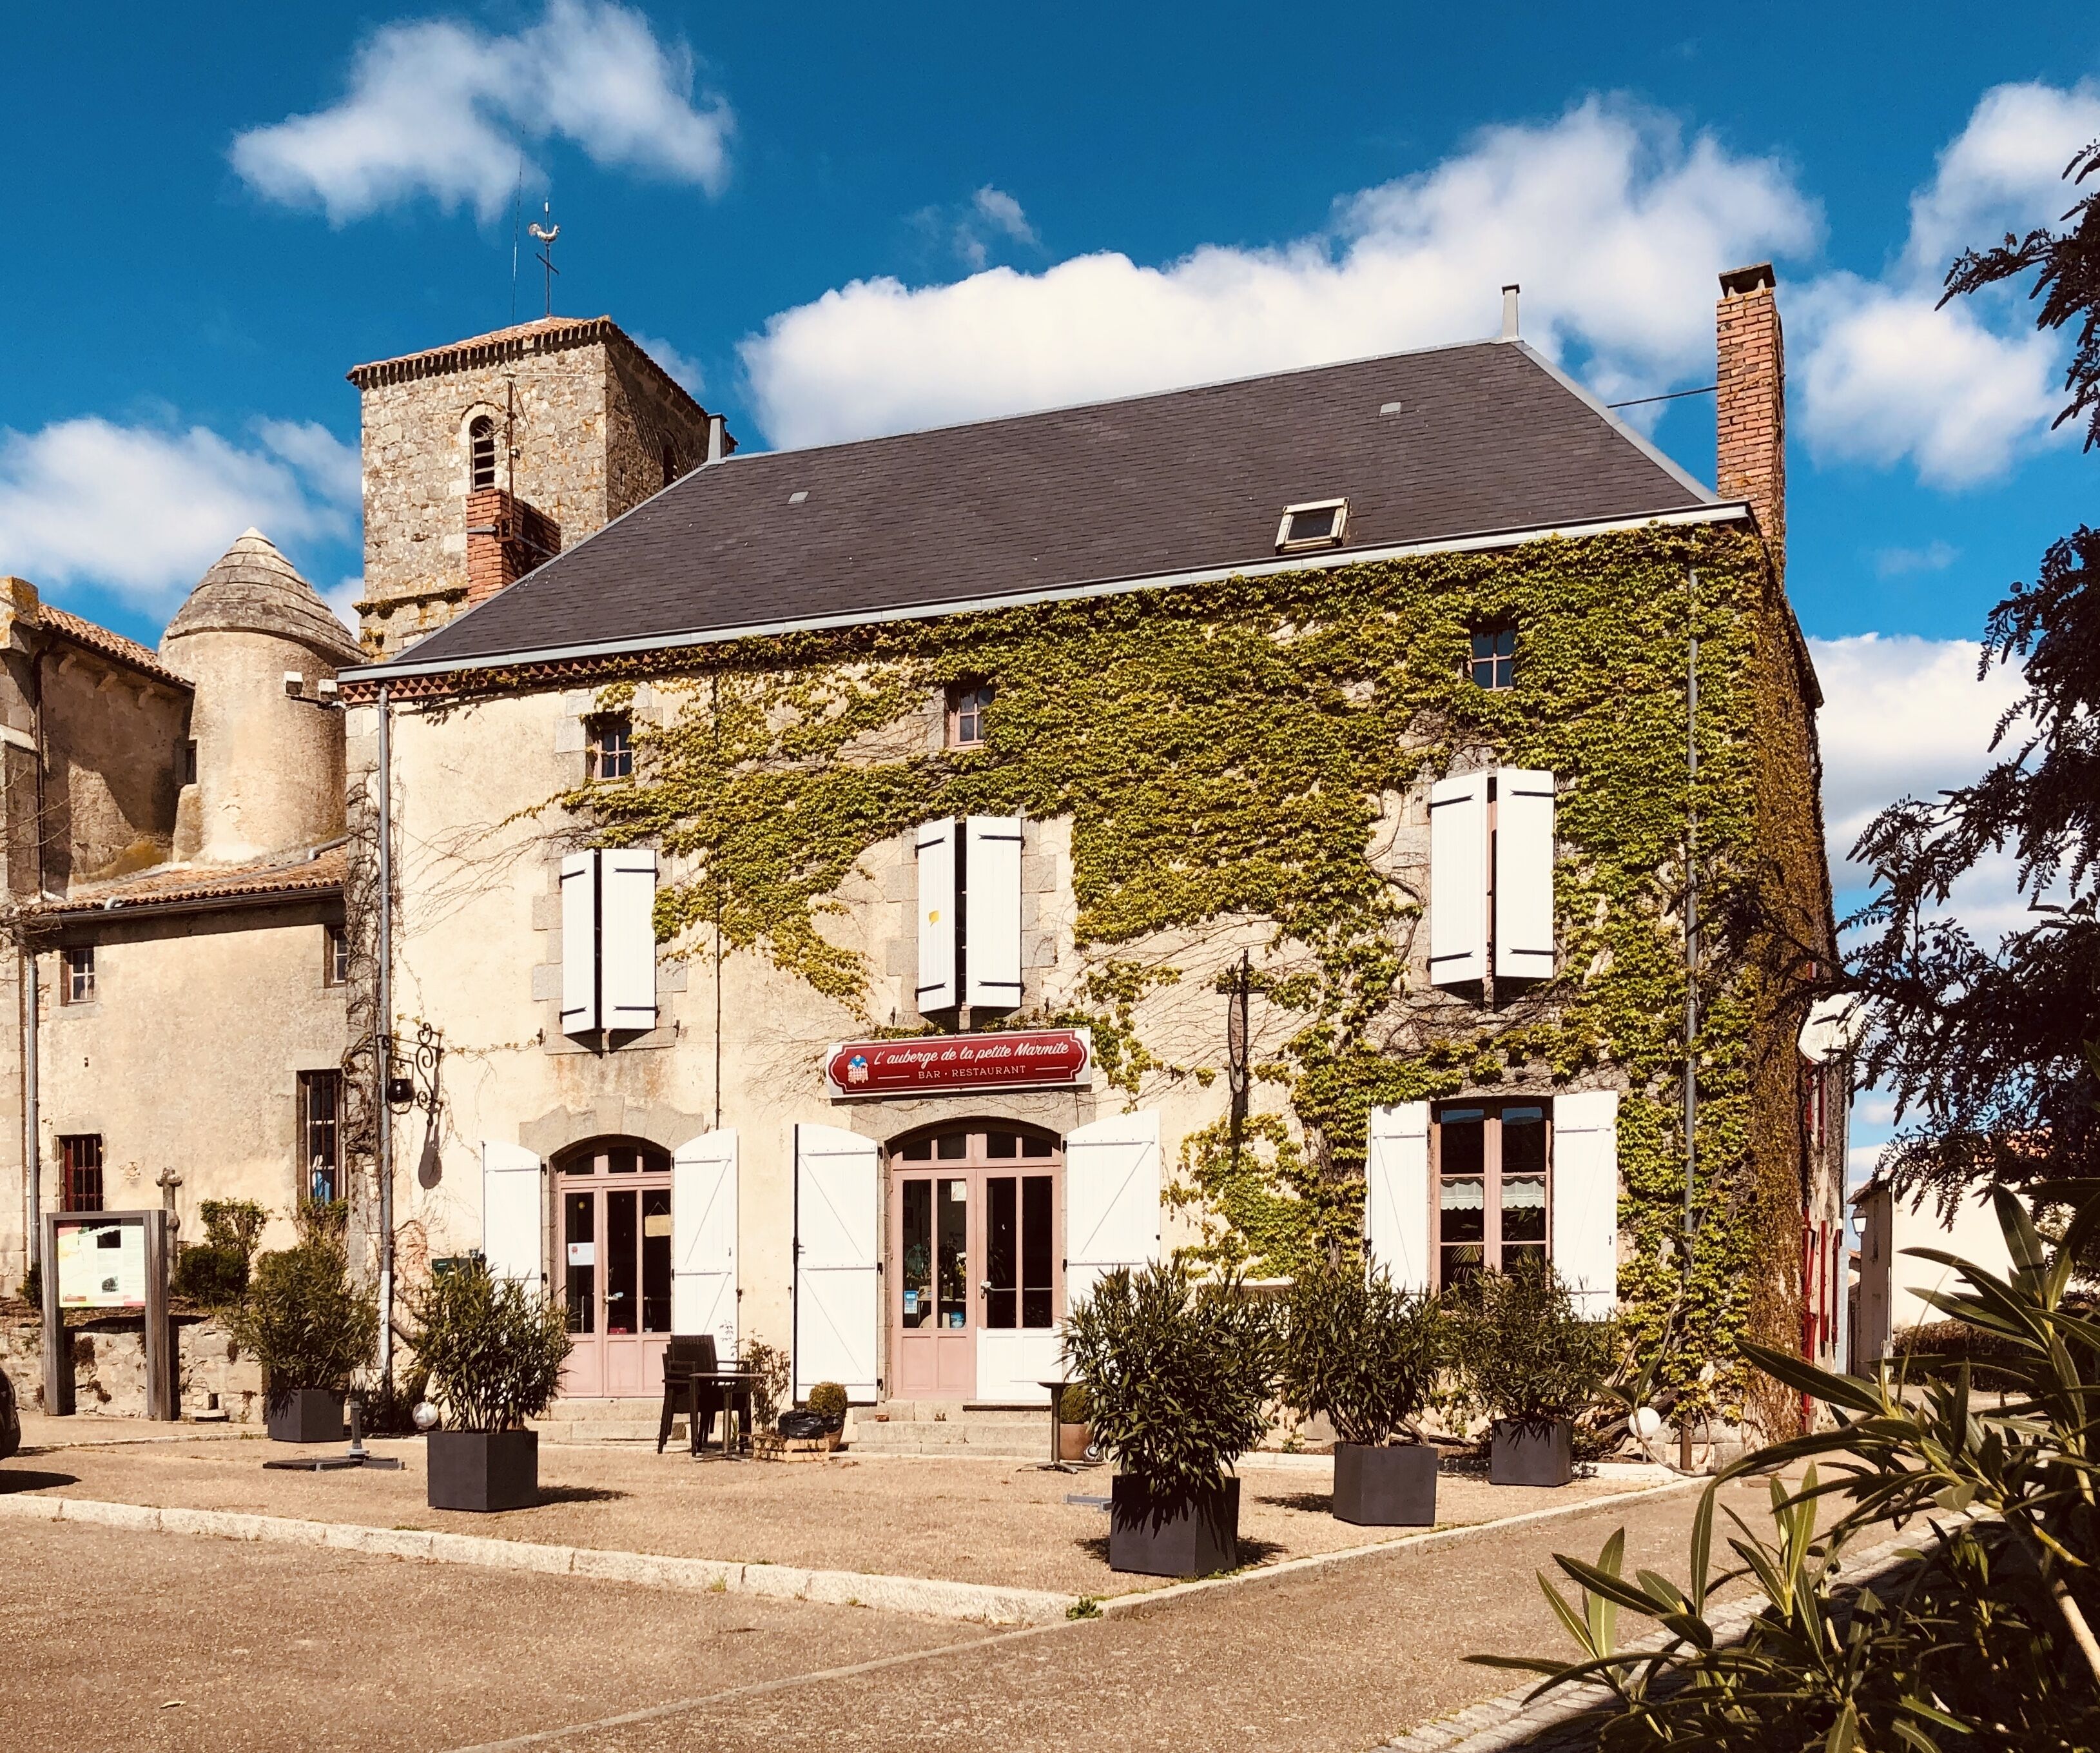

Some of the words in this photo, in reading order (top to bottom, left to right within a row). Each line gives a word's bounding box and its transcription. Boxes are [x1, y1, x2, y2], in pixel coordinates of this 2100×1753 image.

[886, 1048, 938, 1070] auberge
[940, 1046, 957, 1061] de
[959, 1045, 974, 1060] la
[974, 1044, 1013, 1063] petite
[1014, 1042, 1069, 1057] Marmite
[918, 1070, 940, 1080] BAR
[952, 1065, 1026, 1077] RESTAURANT
